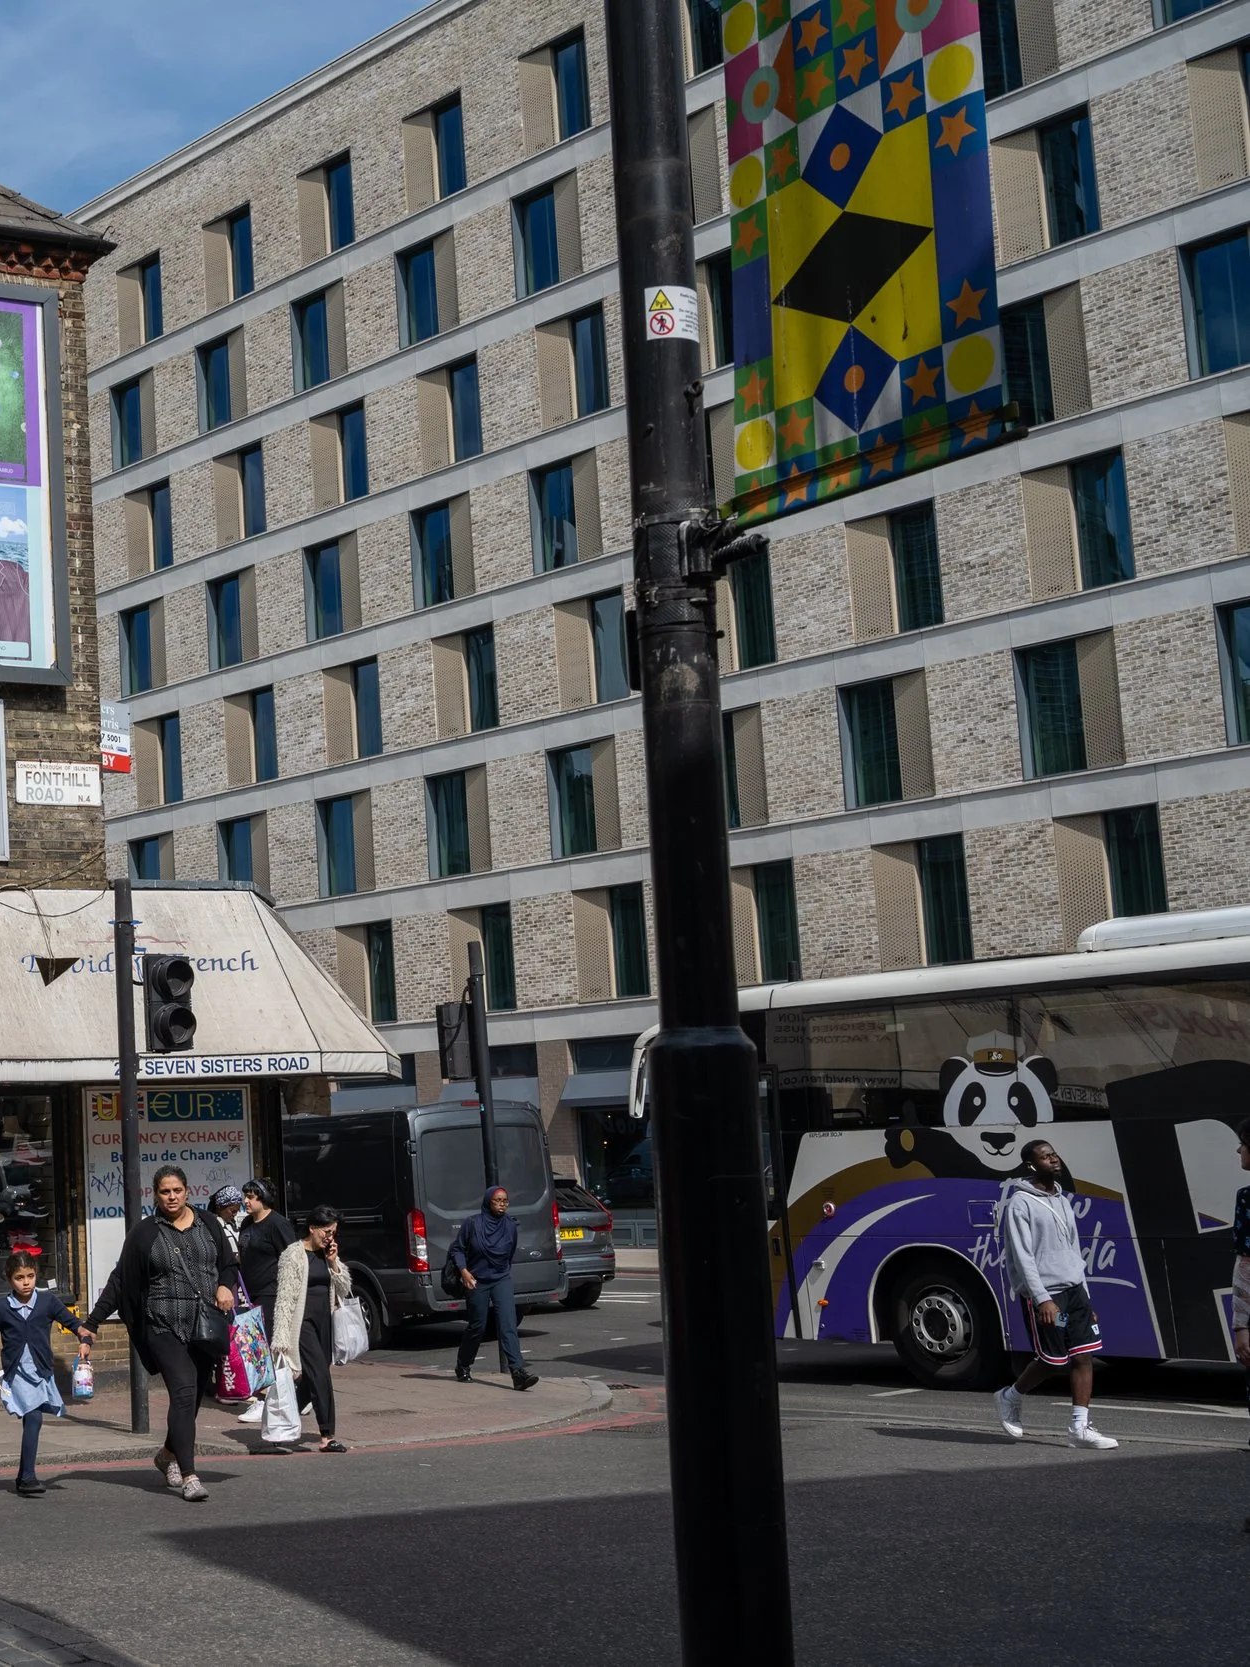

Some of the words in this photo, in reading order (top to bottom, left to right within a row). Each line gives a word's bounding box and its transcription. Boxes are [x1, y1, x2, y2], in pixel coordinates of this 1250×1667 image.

[100, 717, 119, 730] rris
[107, 734, 121, 743] 5001
[102, 753, 116, 767] BY
[25, 770, 91, 788] FONTHILL
[25, 786, 64, 802] ROAD
[78, 794, 91, 803] N.4
[144, 1059, 196, 1076] SEVEN
[200, 1058, 264, 1074] SISTERS
[267, 1056, 310, 1072] ROAD
[92, 1131, 167, 1146] CURNCY
[171, 1128, 245, 1144] EXCHANGE
[161, 1150, 177, 1162] de
[180, 1150, 229, 1164] Change
